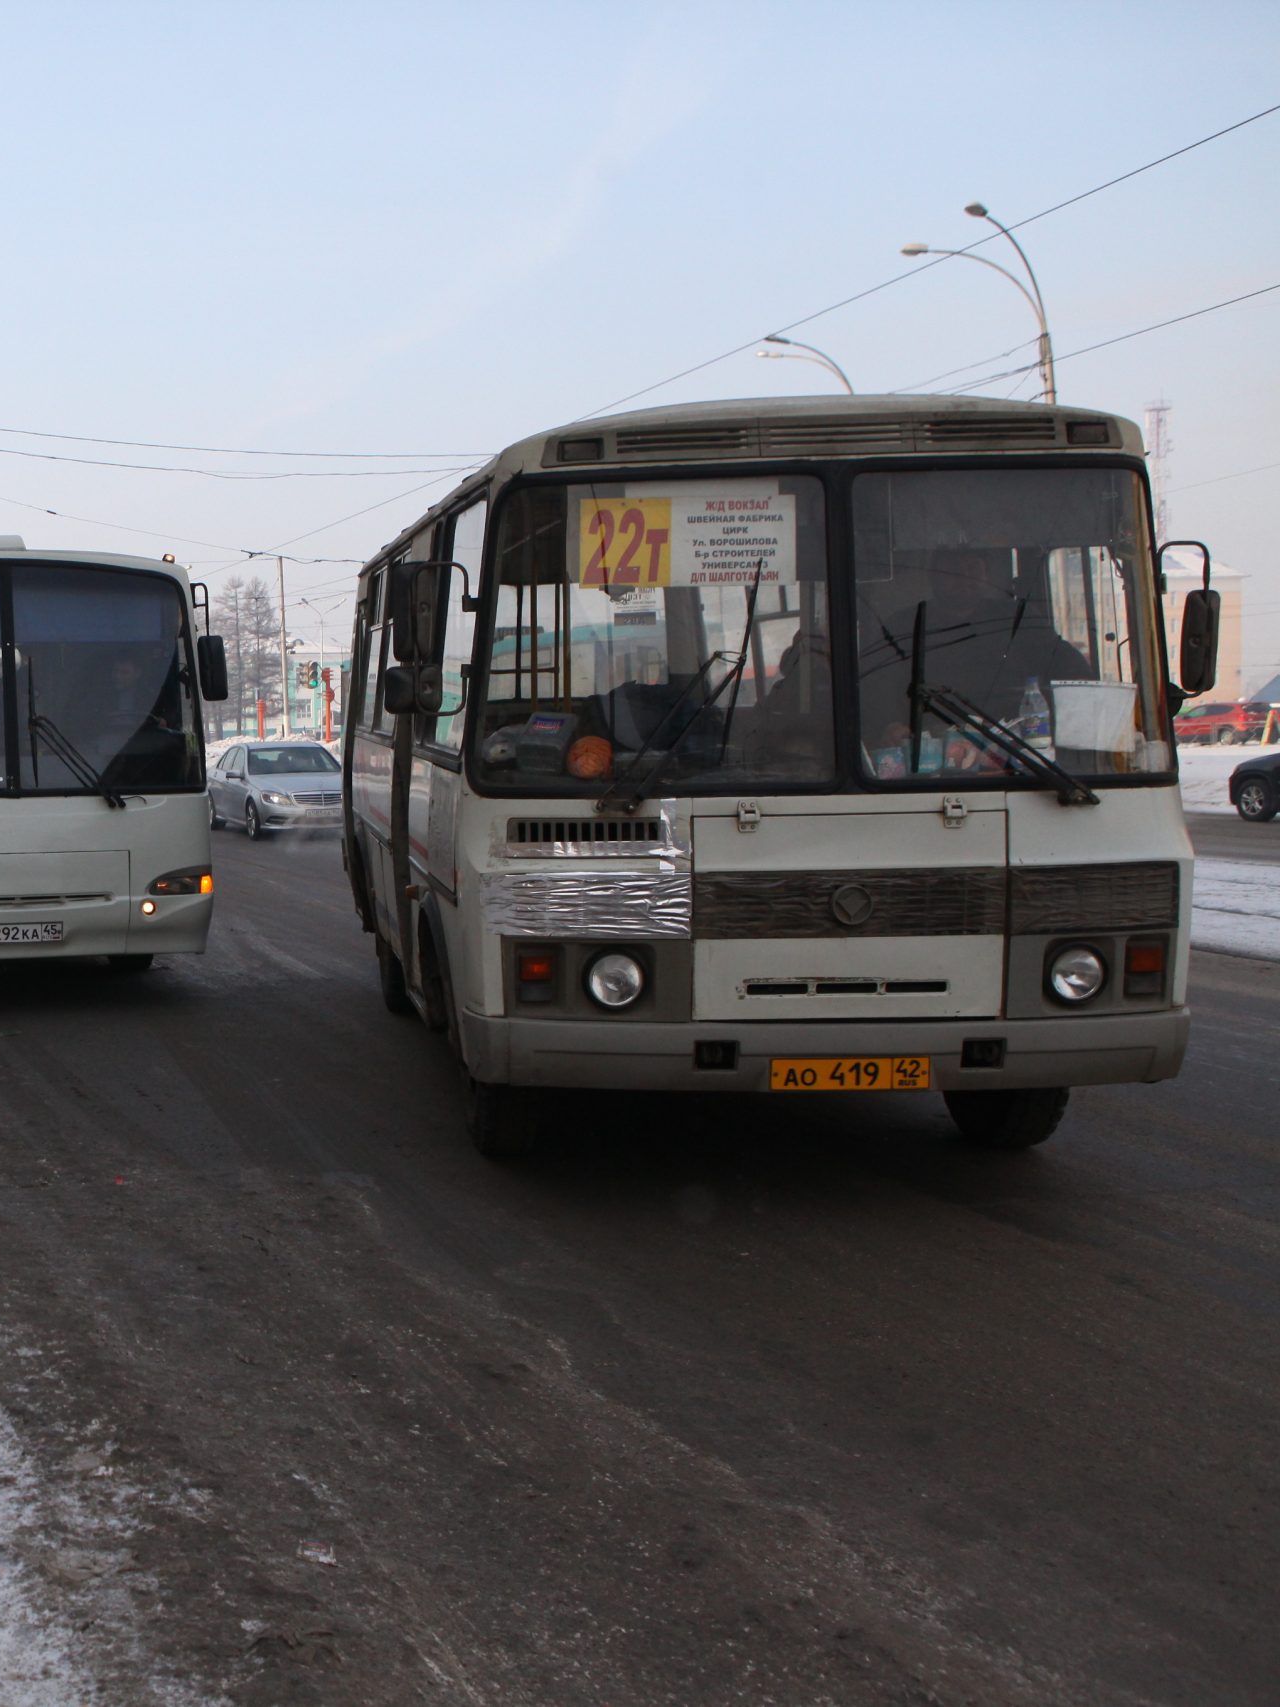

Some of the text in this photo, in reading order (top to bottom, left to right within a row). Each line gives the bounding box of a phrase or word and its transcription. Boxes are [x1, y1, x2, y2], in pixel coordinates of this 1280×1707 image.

[705, 499, 769, 512] Ж/Д ВОКЗАЛ
[687, 514, 784, 524] ШВЕЙНАЯ ФАБРИКА
[722, 526, 749, 535] ЦИРК
[710, 537, 778, 547] ВОРОШИЛОВА
[694, 548, 776, 559] Б-р СТРОИТЕЛЕЙ
[43, 924, 57, 935] 45
[783, 1059, 921, 1087] АО 419 42
